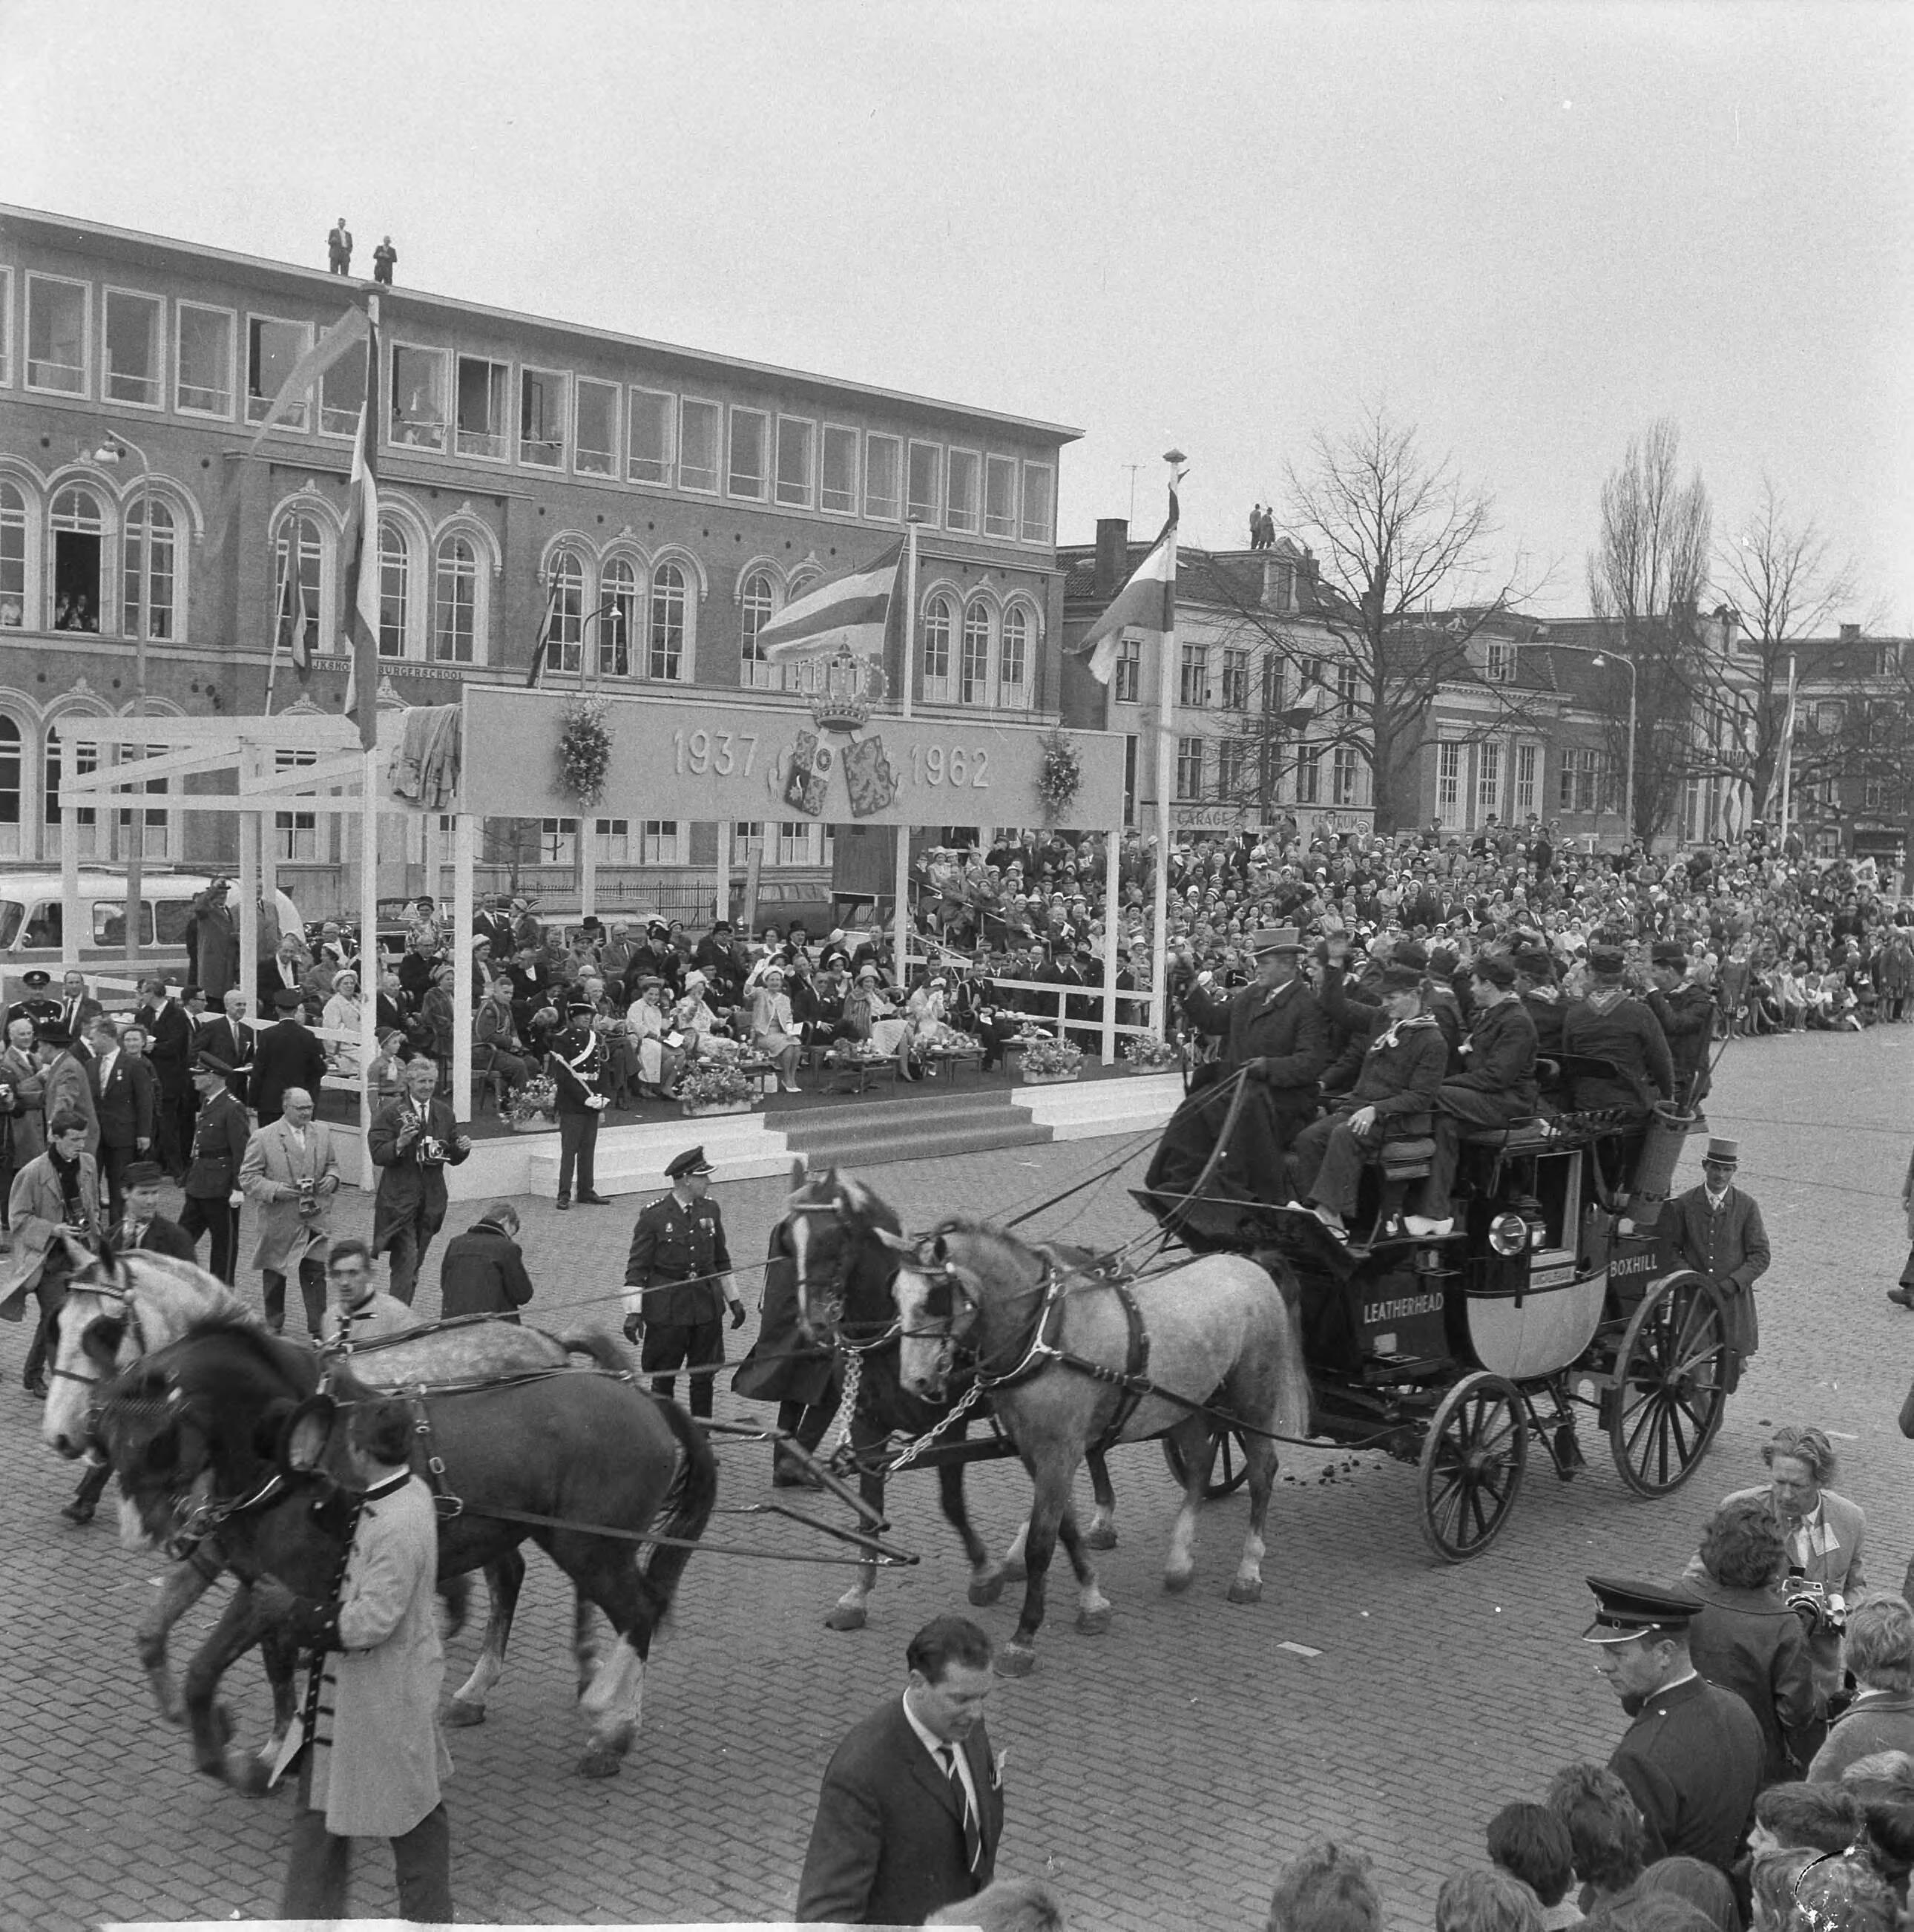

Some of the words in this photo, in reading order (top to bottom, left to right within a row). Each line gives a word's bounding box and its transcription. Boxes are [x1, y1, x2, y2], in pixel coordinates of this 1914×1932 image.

[673, 729, 757, 777] 1937
[911, 743, 991, 788] 1962
[1610, 1253, 1658, 1278] BOXHILL
[1364, 1292, 1444, 1324] LEATHERHEAD
